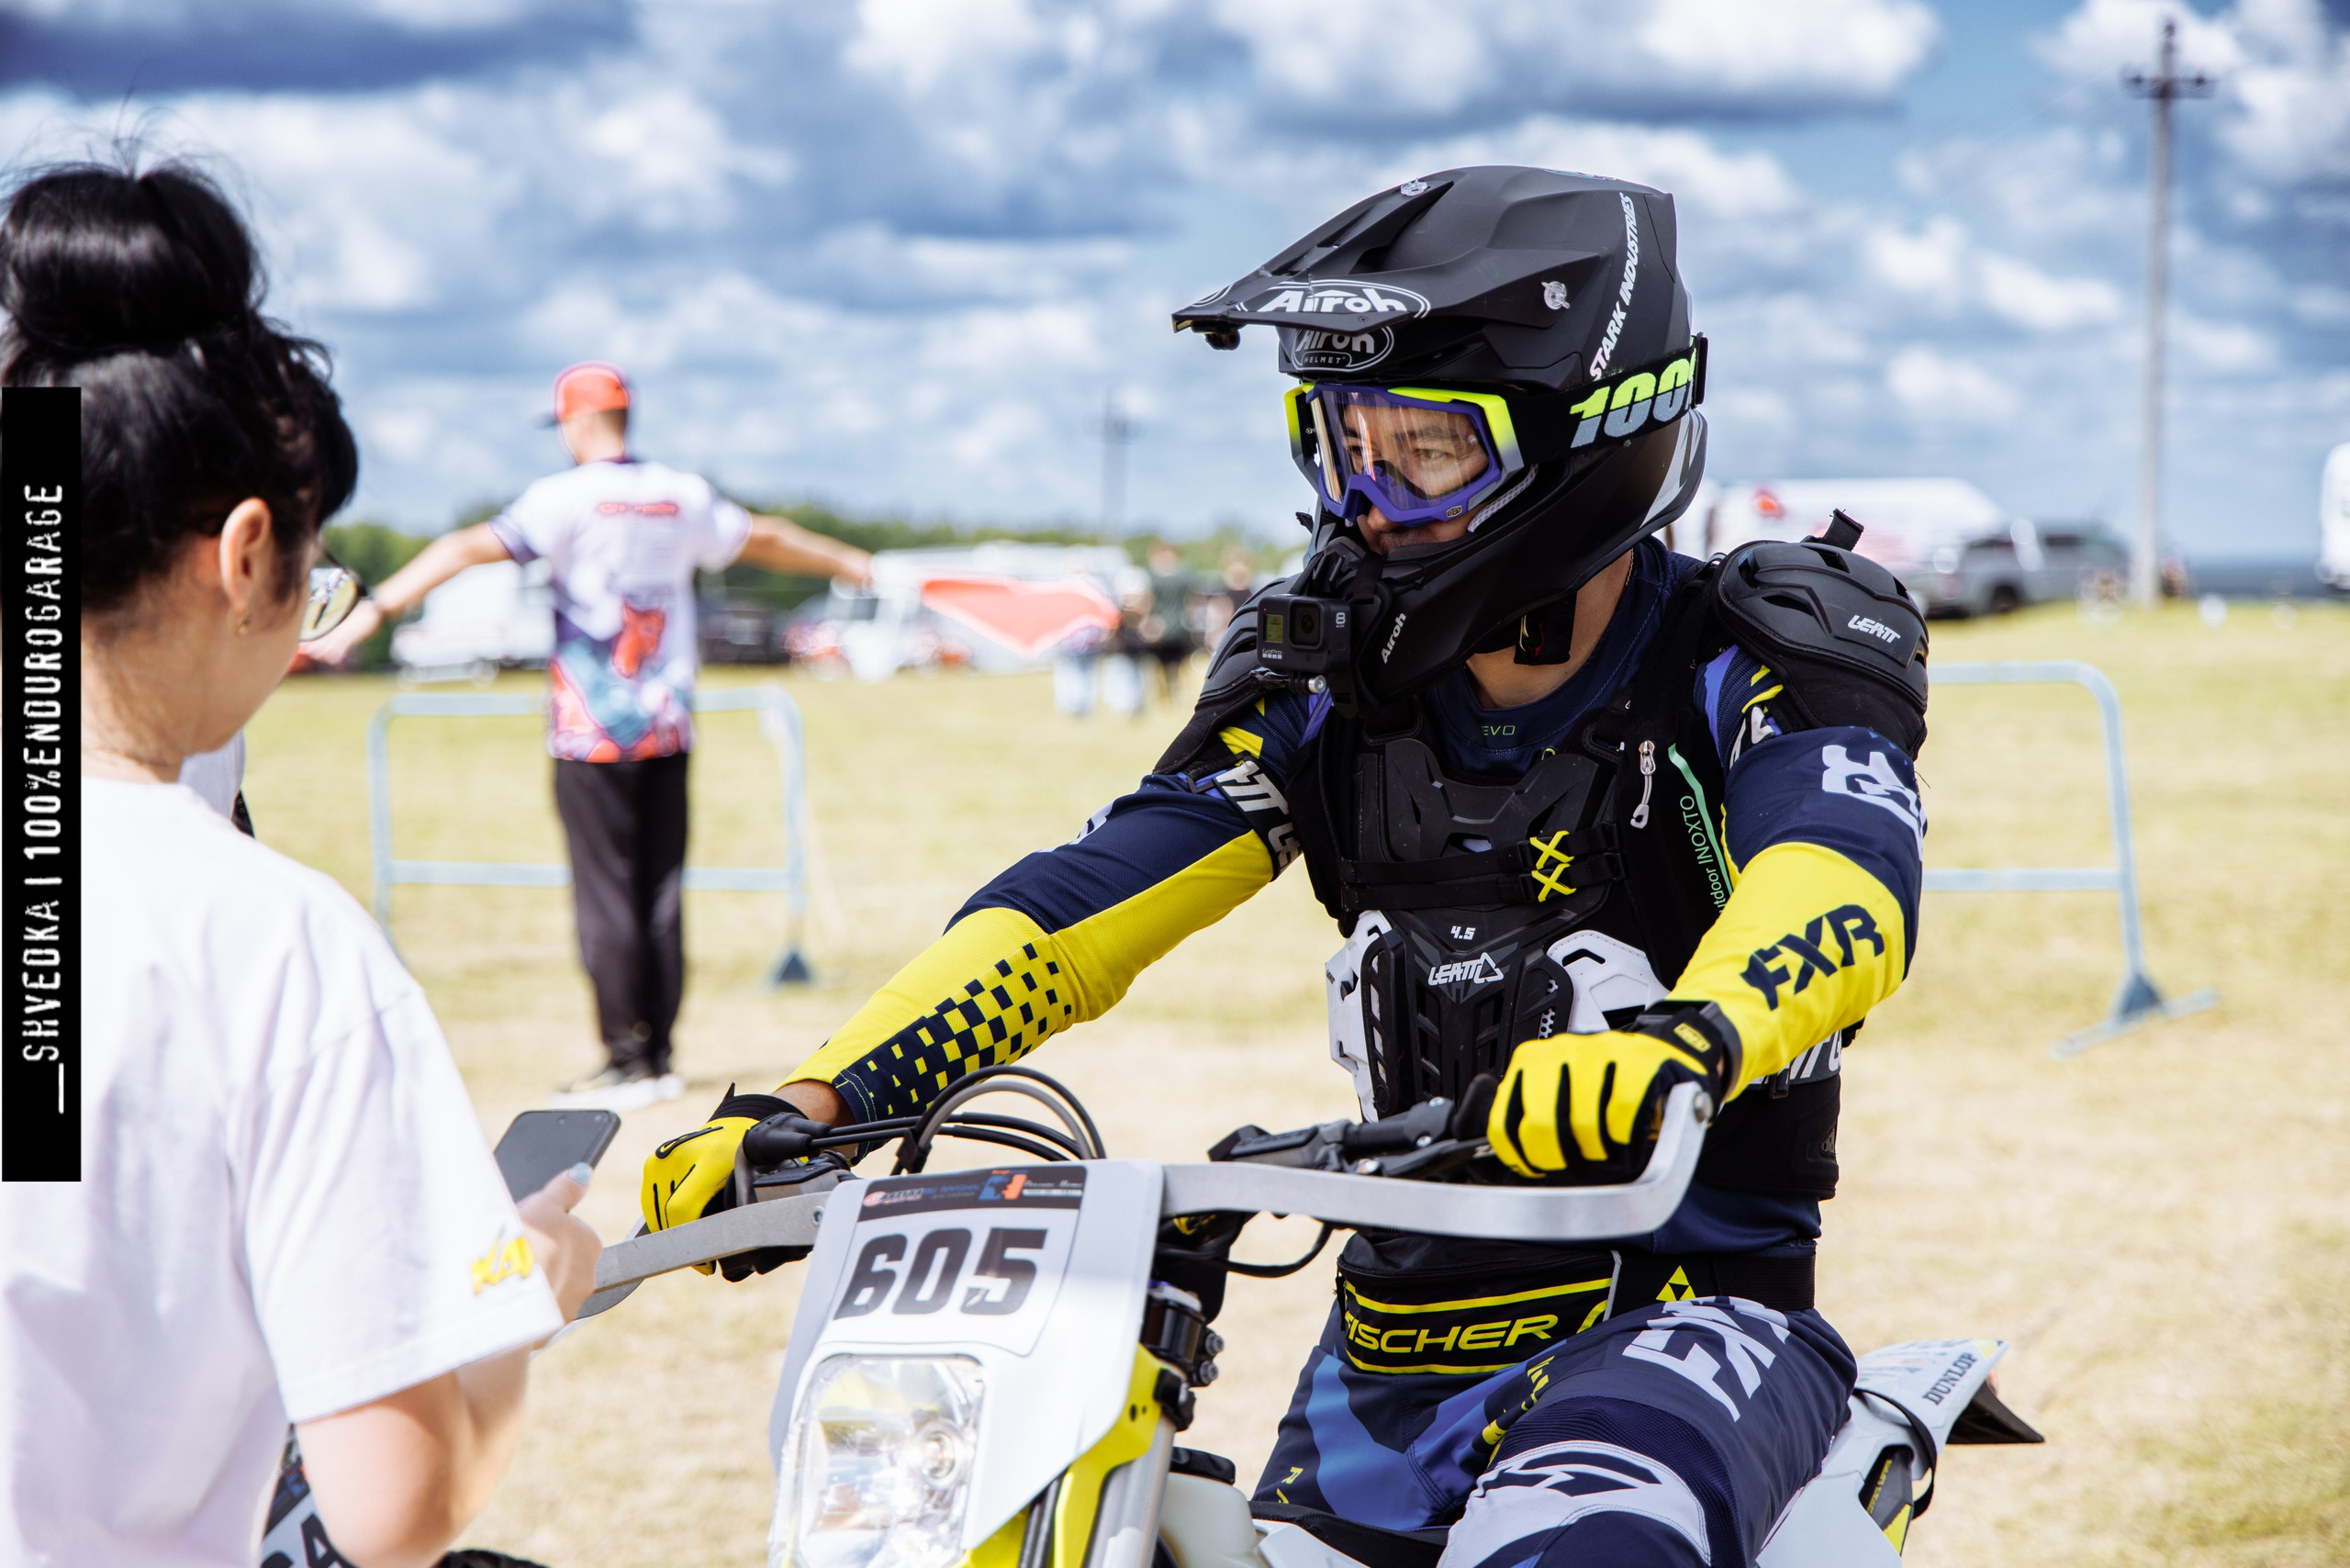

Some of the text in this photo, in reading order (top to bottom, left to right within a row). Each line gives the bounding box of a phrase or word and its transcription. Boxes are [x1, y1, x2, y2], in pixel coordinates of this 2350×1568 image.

[1257, 287, 1408, 313] Airoh
[1589, 191, 1639, 382] STARK INDUSTRIES
[1304, 356, 1341, 364] HELMET
[1335, 611, 1346, 624] 8
[1847, 614, 1902, 644] LEATT
[1381, 612, 1407, 665] Airoh
[1482, 724, 1516, 735] EVO
[1679, 795, 1714, 865] INOXTO
[1449, 925, 1476, 941] 4.5
[1427, 958, 1483, 986] LEATT
[1739, 903, 1886, 1013] FXR
[832, 1226, 1049, 1321] 605
[1921, 1351, 1978, 1406] DUNLOP
